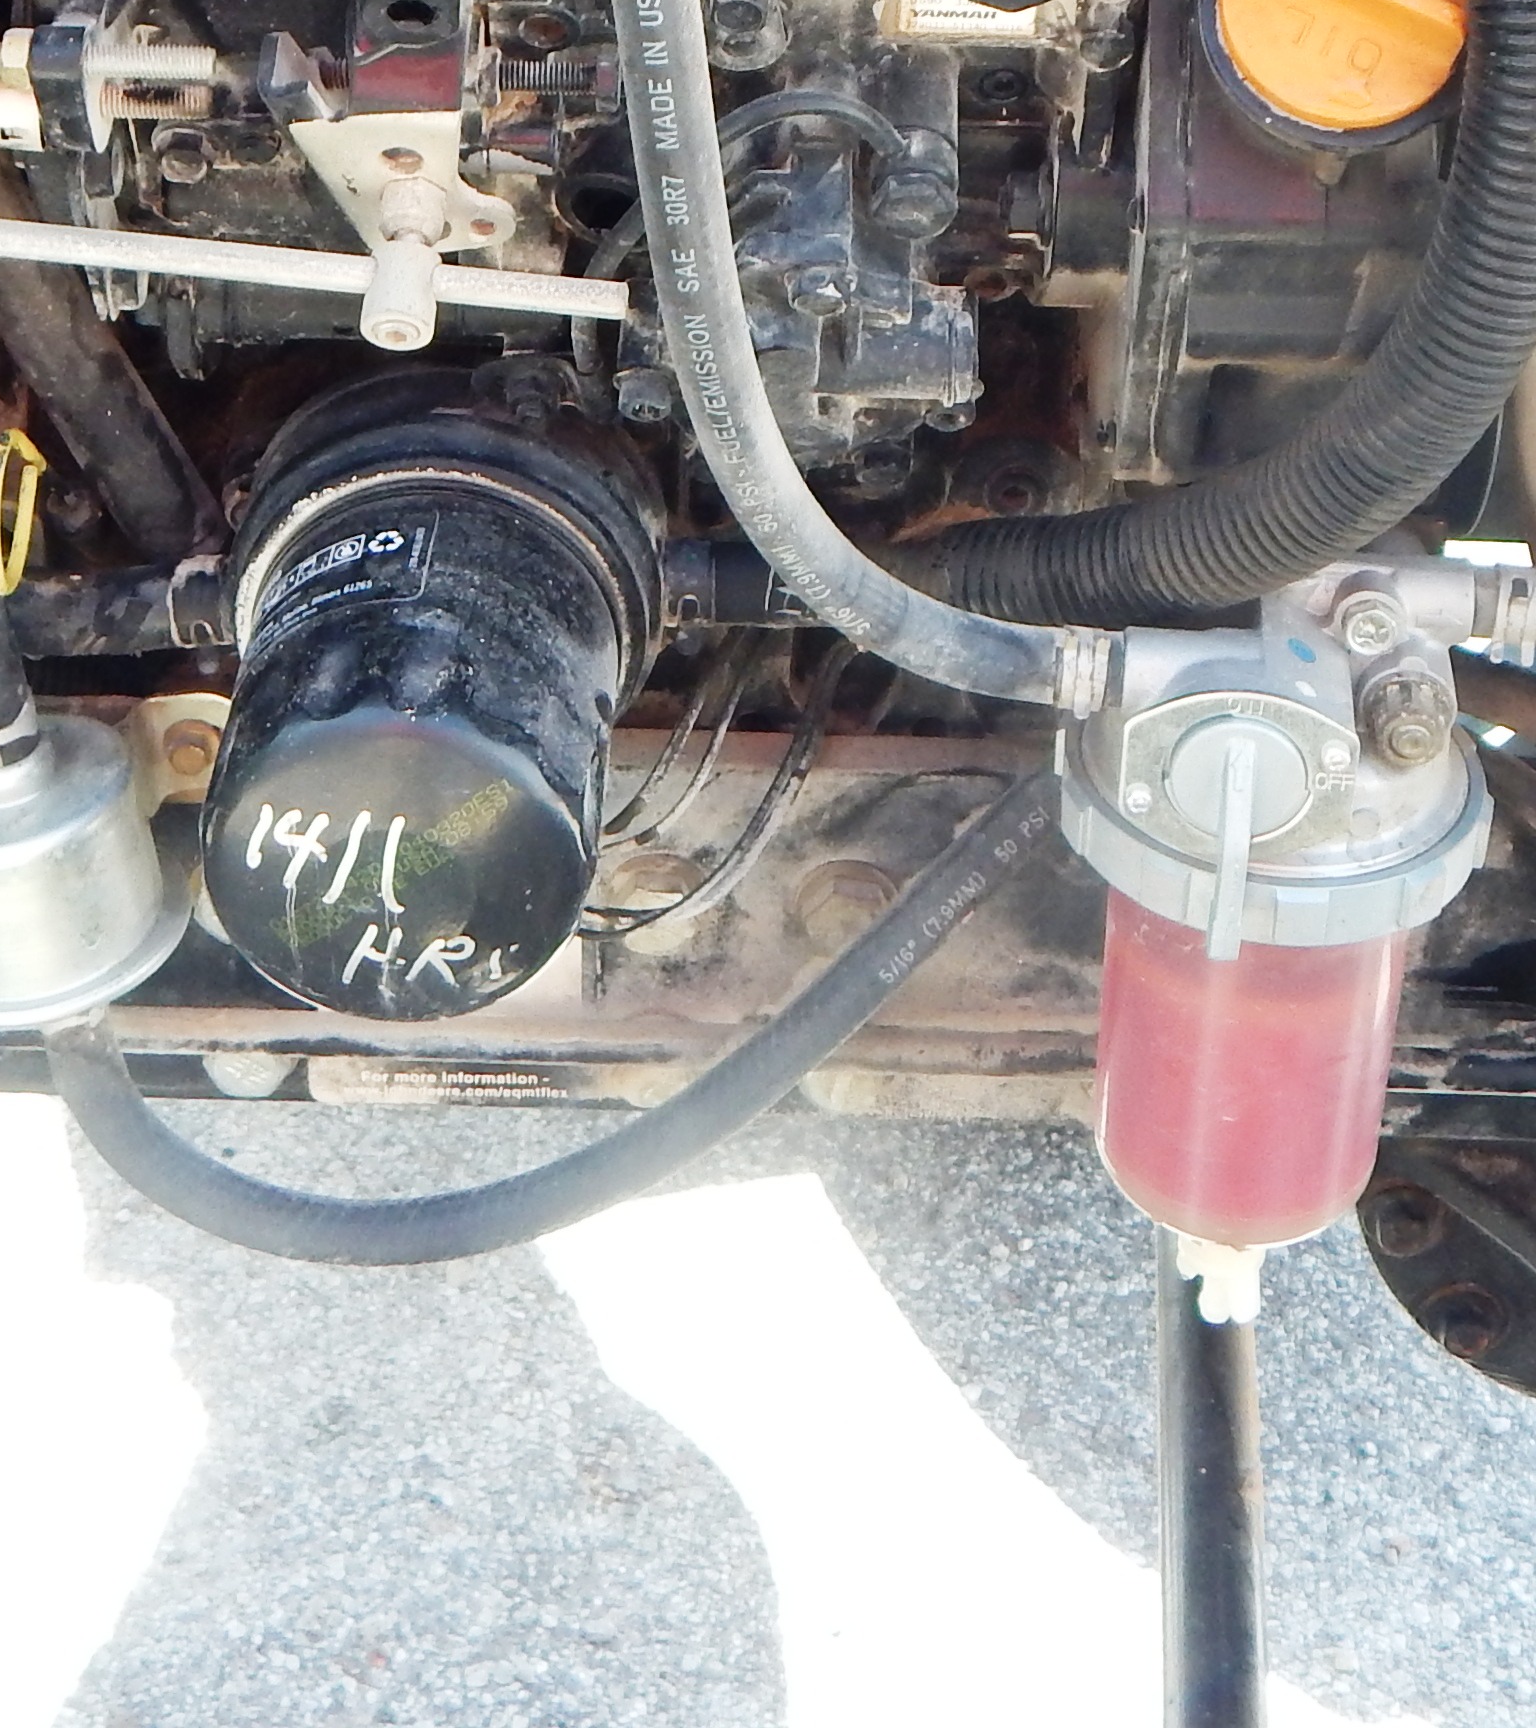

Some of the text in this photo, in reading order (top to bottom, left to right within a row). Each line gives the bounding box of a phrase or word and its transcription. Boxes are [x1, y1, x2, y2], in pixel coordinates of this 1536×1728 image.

[644, 39, 669, 71] IN
[647, 76, 681, 152] MADE
[661, 173, 691, 227] 30R7
[670, 247, 700, 295] SAE
[683, 311, 746, 468] FUEL/EMISSION
[1314, 772, 1356, 792] OFF
[245, 802, 407, 915] 1411
[993, 838, 1019, 864] 50
[1018, 805, 1051, 839] PSI
[394, 1073, 438, 1084] more
